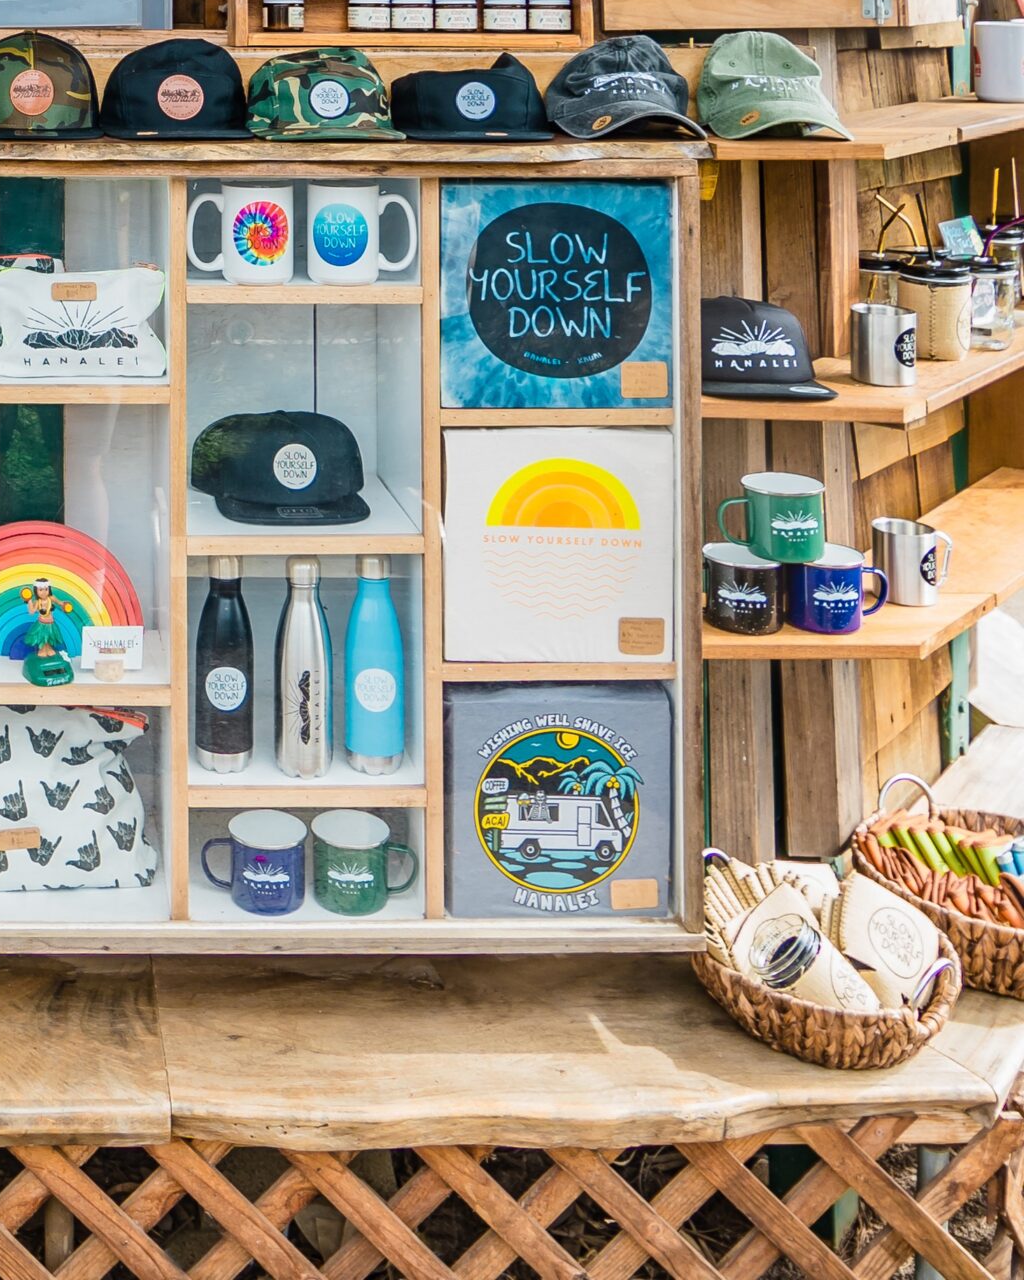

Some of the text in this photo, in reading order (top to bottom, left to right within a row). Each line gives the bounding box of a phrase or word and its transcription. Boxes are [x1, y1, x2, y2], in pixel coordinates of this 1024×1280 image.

[314, 92, 344, 100] YOURSELF
[321, 87, 337, 95] SLOW
[466, 88, 486, 96] SLOW
[321, 98, 338, 106] DOWN
[460, 93, 491, 102] YOURSELF
[466, 100, 486, 108] DOWN
[323, 212, 355, 224] SLOW
[315, 224, 368, 238] YOURSELF
[323, 237, 356, 250] DOWN
[505, 231, 608, 265] SLOW
[469, 267, 647, 303] YOURSELF
[508, 305, 612, 339] DOWN
[24, 356, 139, 366] HANALEI
[523, 351, 562, 366] HANALEI
[715, 359, 798, 372] HANALEI
[284, 451, 307, 460] SLOW
[276, 460, 315, 470] YOURSELF
[283, 469, 308, 479] DOWN
[772, 528, 819, 538] HANALEI
[483, 534, 643, 549] SLOW YOURSELF DOWN
[718, 597, 768, 610] HANALEI
[813, 599, 858, 609] HANALEI
[102, 639, 135, 649] HANALEI
[214, 673, 238, 682] SLOW
[363, 674, 387, 684] SLOW
[207, 682, 247, 692] YOURSELF
[214, 691, 239, 701] DOWN
[364, 692, 388, 702] DOWN
[477, 714, 638, 762] WISHING WELL SHAVE ICE
[484, 780, 507, 791] COFFEE
[484, 815, 507, 827] ACAI
[243, 880, 290, 889] HANALEI
[328, 880, 375, 889] HANALEI
[513, 887, 601, 912] HANALEI
